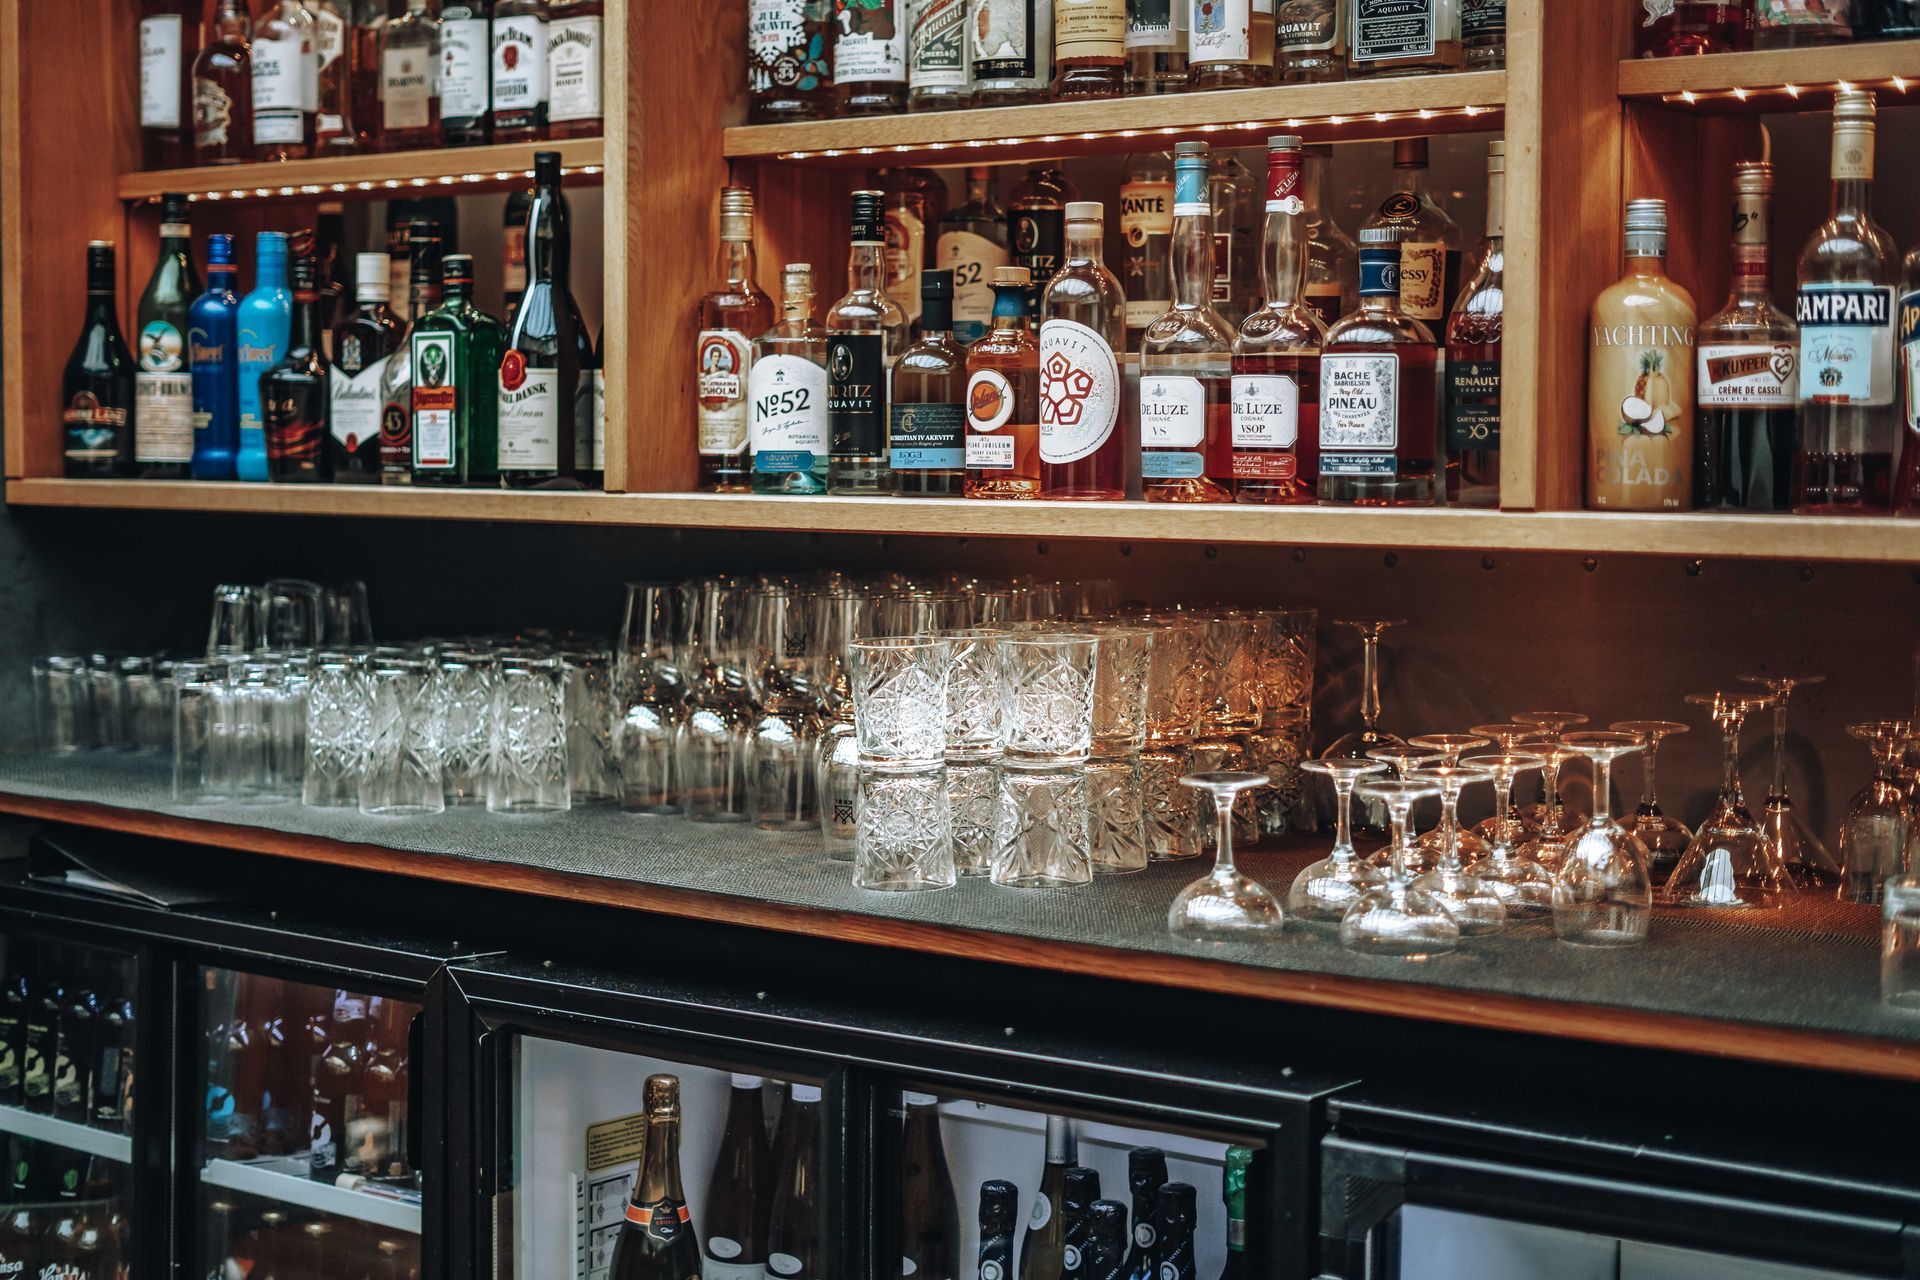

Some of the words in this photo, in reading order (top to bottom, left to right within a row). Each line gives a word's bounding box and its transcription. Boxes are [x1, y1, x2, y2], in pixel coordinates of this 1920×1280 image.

[1377, 5, 1410, 14] AQUAVIT
[1132, 21, 1172, 33] Original
[1796, 294, 1886, 322] CAMPARI
[1594, 325, 1696, 347] YACHTING
[1722, 355, 1768, 377] KUYPER
[1334, 371, 1371, 380] BACHE
[1454, 376, 1500, 386] RENAULT
[1718, 383, 1743, 395] CRÈME
[1745, 386, 1755, 395] DE
[1757, 386, 1782, 395] CASSIS
[1153, 403, 1189, 415] LUZE
[1232, 402, 1244, 415] DE
[1246, 402, 1283, 415] LUZE
[1329, 397, 1377, 410] PINEAU
[384, 411, 402, 431] 43
[1152, 426, 1167, 436] VS
[1241, 424, 1266, 433] VSOP
